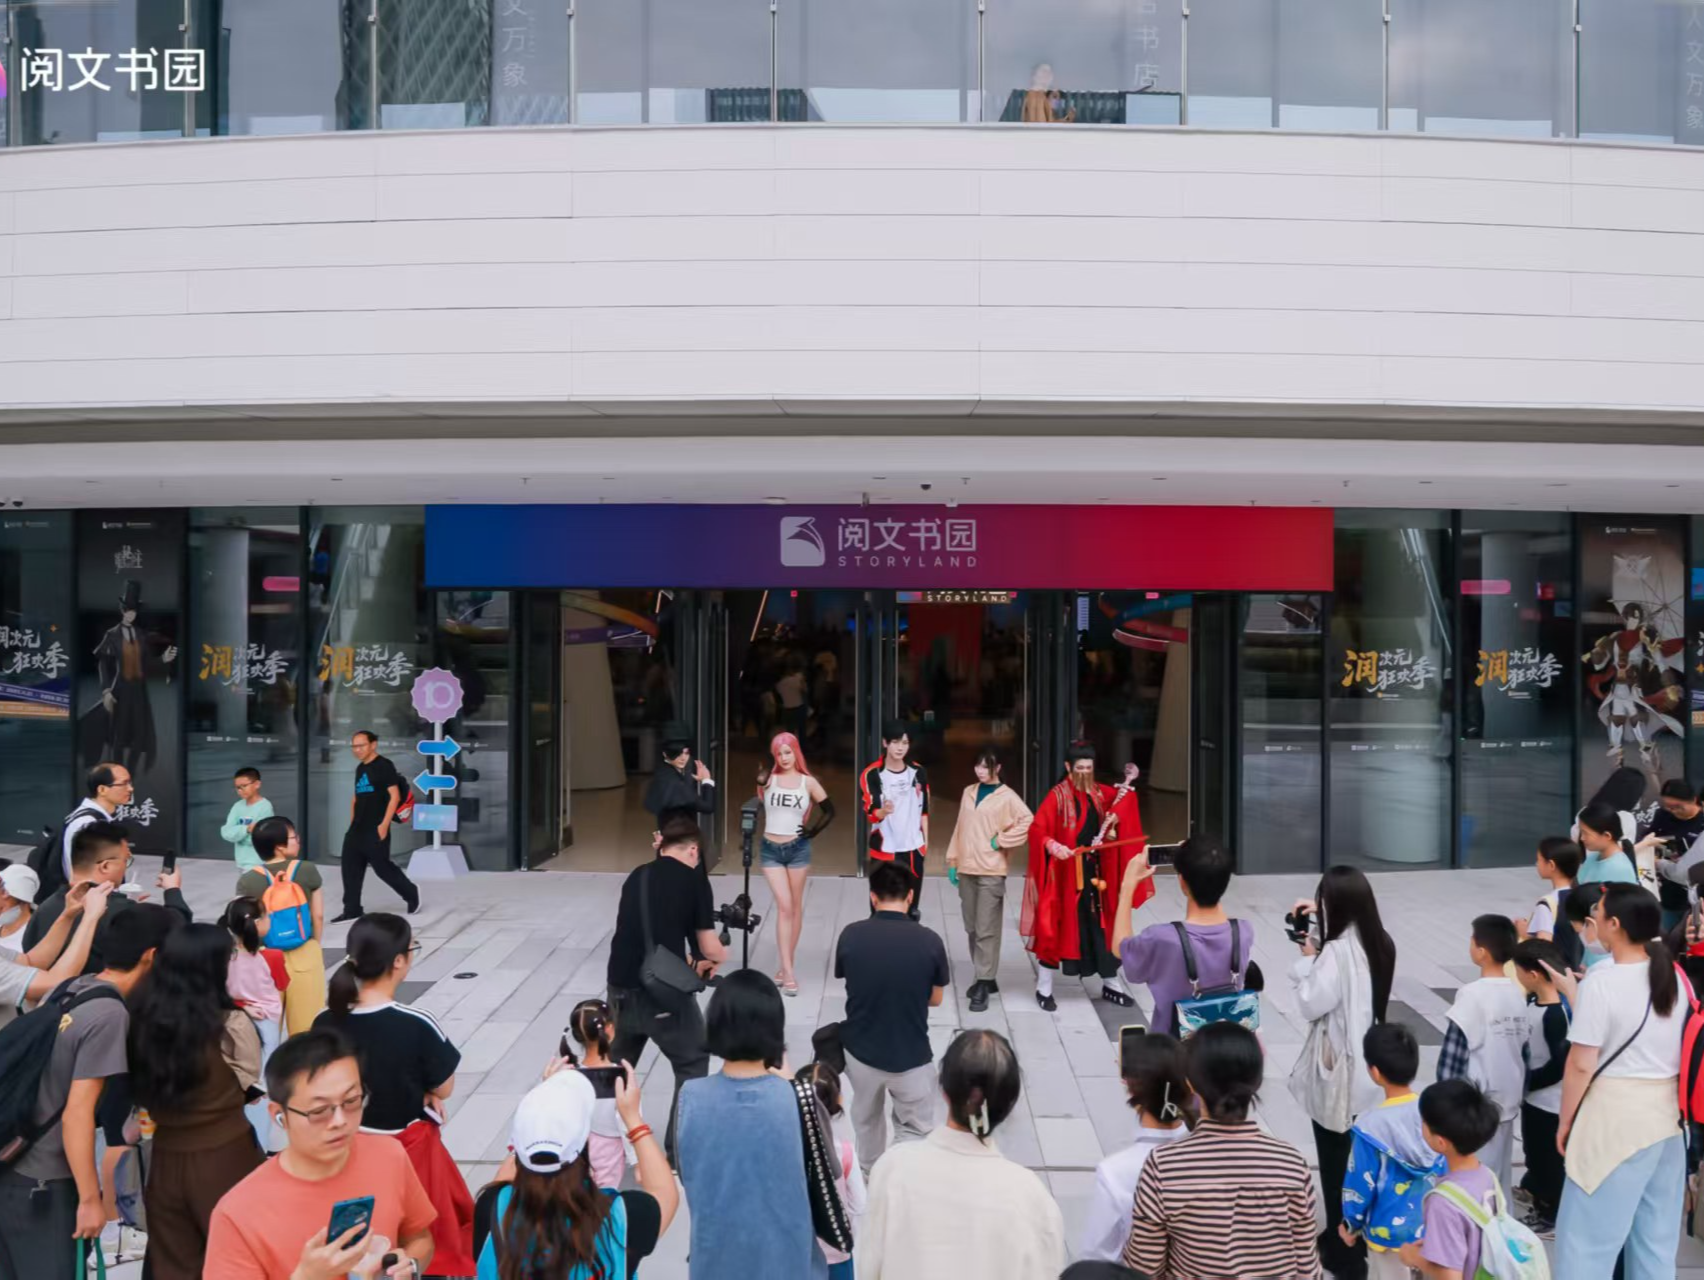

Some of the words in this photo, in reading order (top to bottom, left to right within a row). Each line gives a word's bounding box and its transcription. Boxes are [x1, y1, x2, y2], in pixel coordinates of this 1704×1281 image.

[837, 517, 978, 552] 阅文书园
[837, 556, 978, 568] STORYLAND
[926, 594, 1008, 603] STORYLAND
[769, 791, 805, 810] HEX
